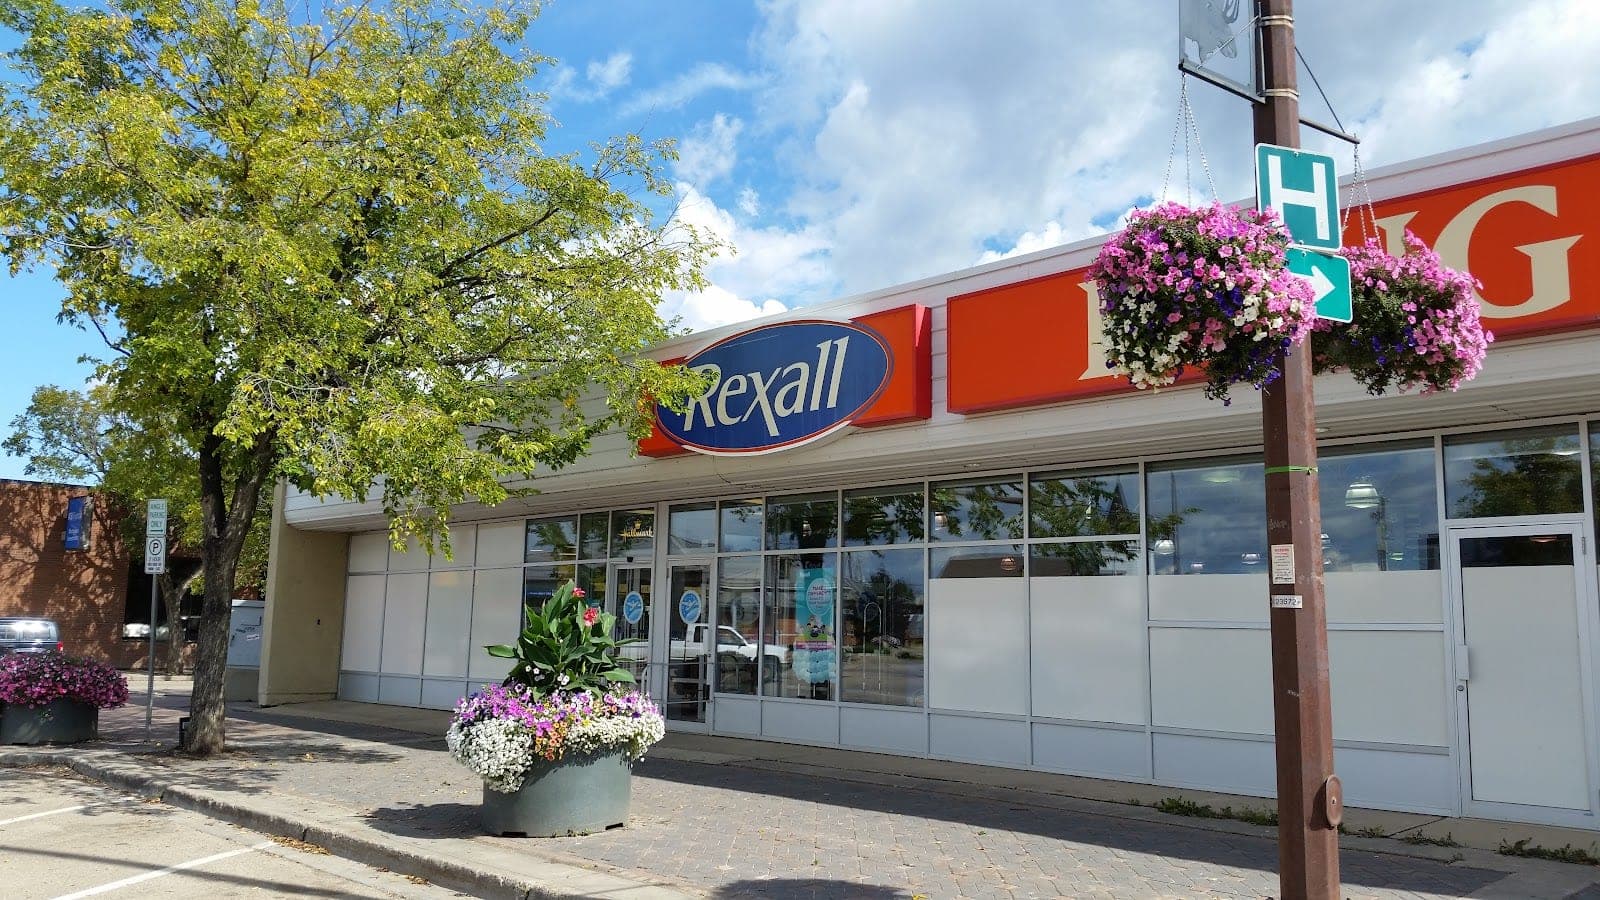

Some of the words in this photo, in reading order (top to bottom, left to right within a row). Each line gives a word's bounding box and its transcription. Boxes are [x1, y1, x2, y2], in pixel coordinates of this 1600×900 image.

[1267, 154, 1330, 240] H
[684, 335, 850, 437] Rexall
[150, 520, 162, 528] ONLY
[618, 525, 654, 543] Hallmark
